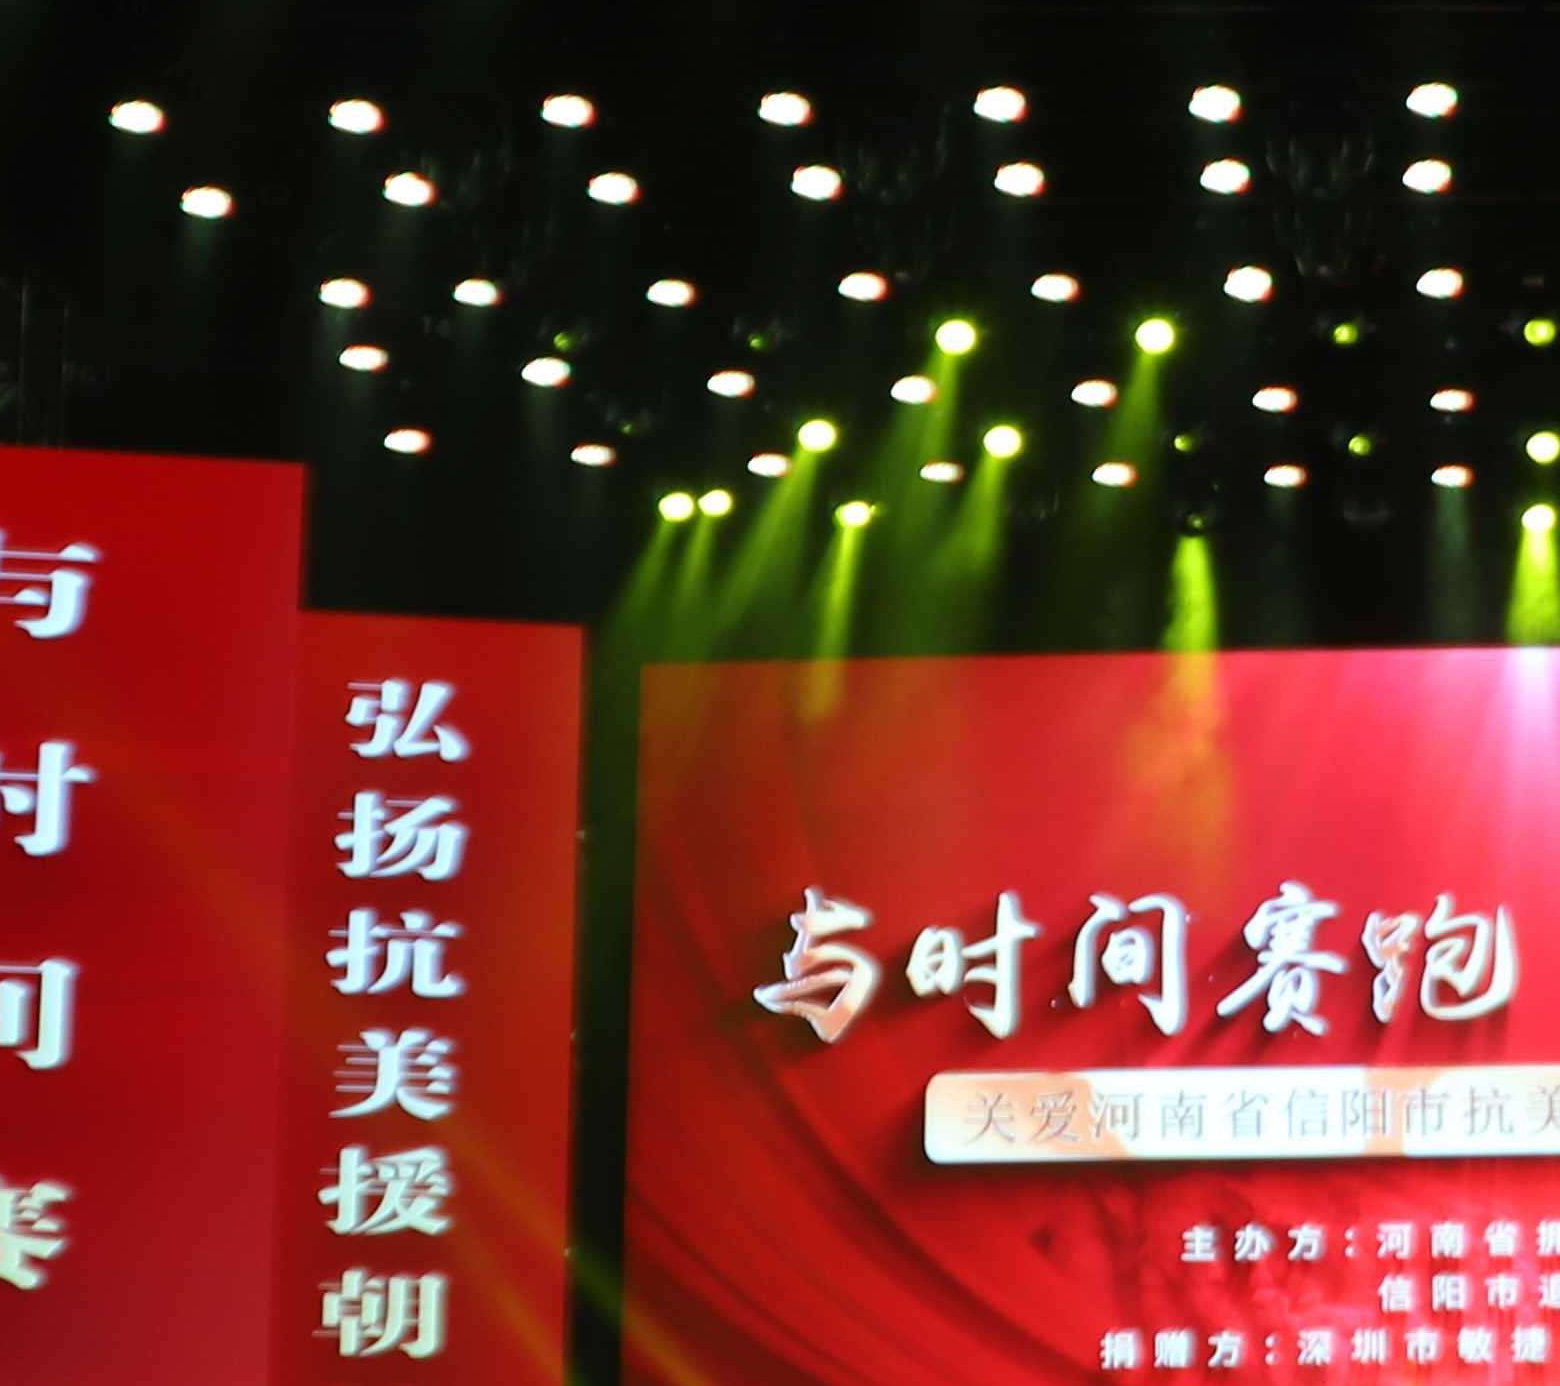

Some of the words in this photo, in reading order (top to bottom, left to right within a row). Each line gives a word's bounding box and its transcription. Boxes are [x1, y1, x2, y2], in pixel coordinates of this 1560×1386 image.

[753, 880, 1520, 1043] 与时间赛跑
